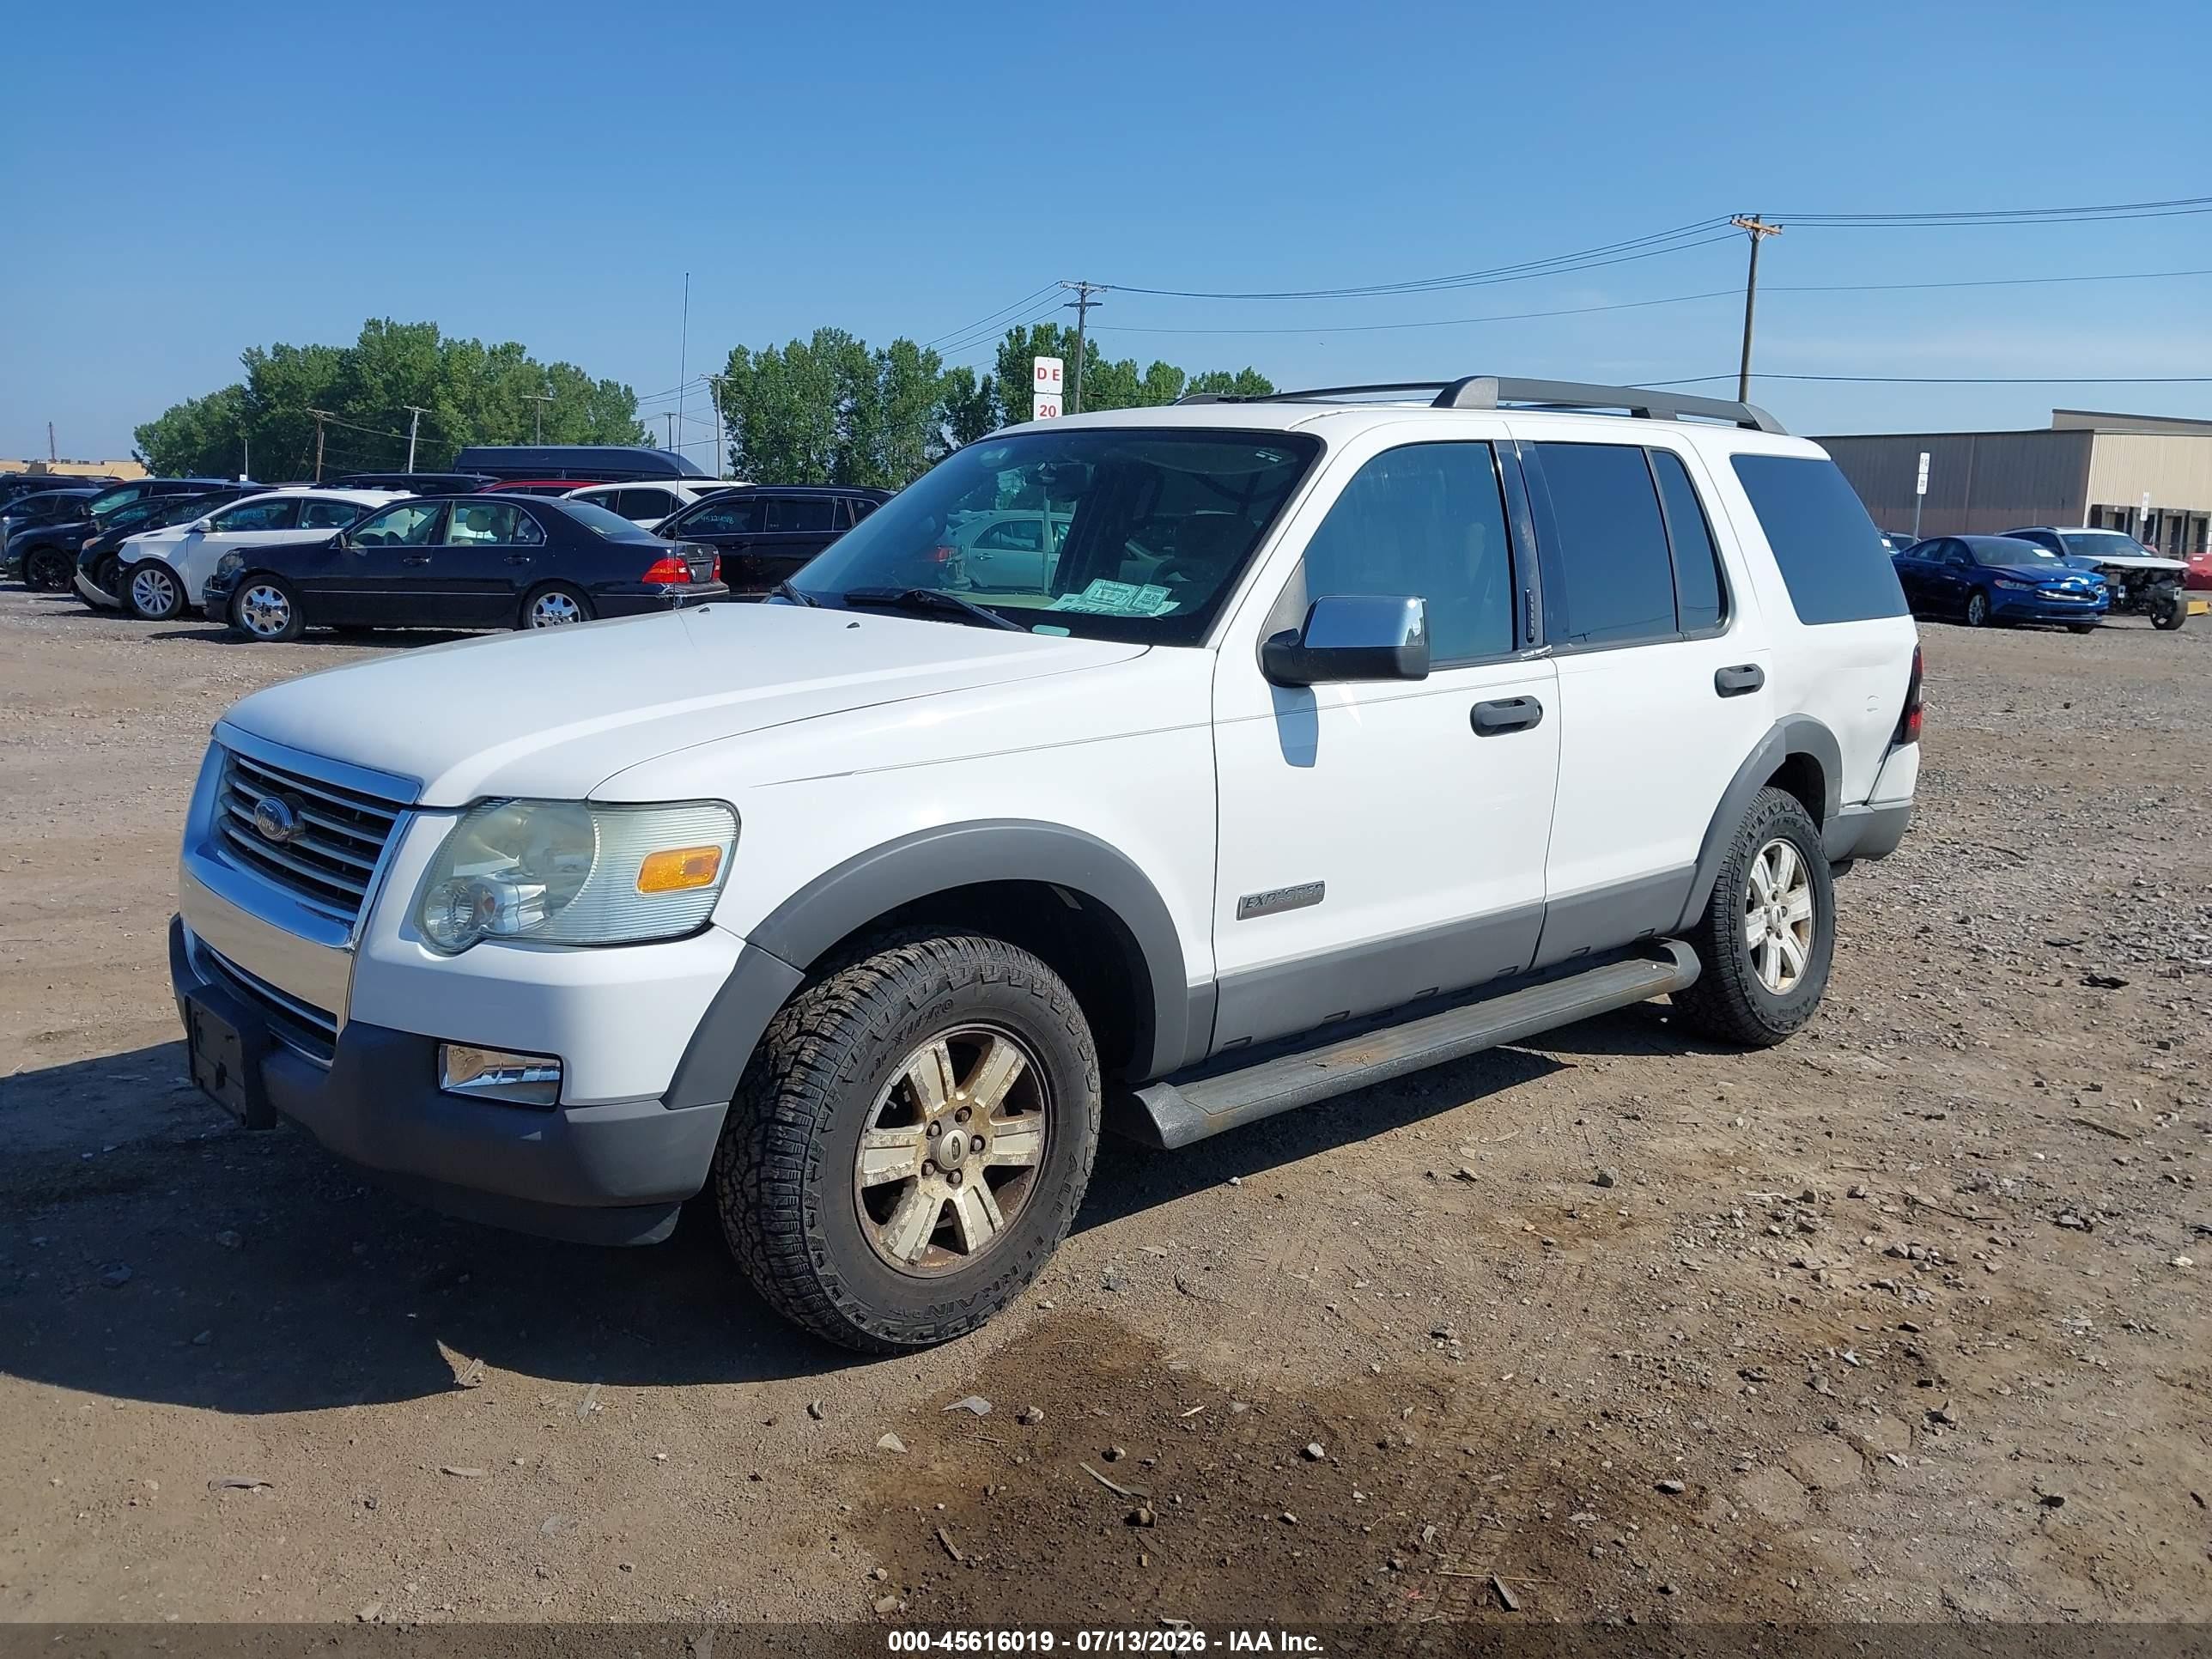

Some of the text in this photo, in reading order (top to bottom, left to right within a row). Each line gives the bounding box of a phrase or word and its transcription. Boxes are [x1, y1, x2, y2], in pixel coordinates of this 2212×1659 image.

[1037, 368, 1060, 380] D E
[1040, 405, 1056, 417] 20
[1245, 883, 1326, 908] EXPLORER
